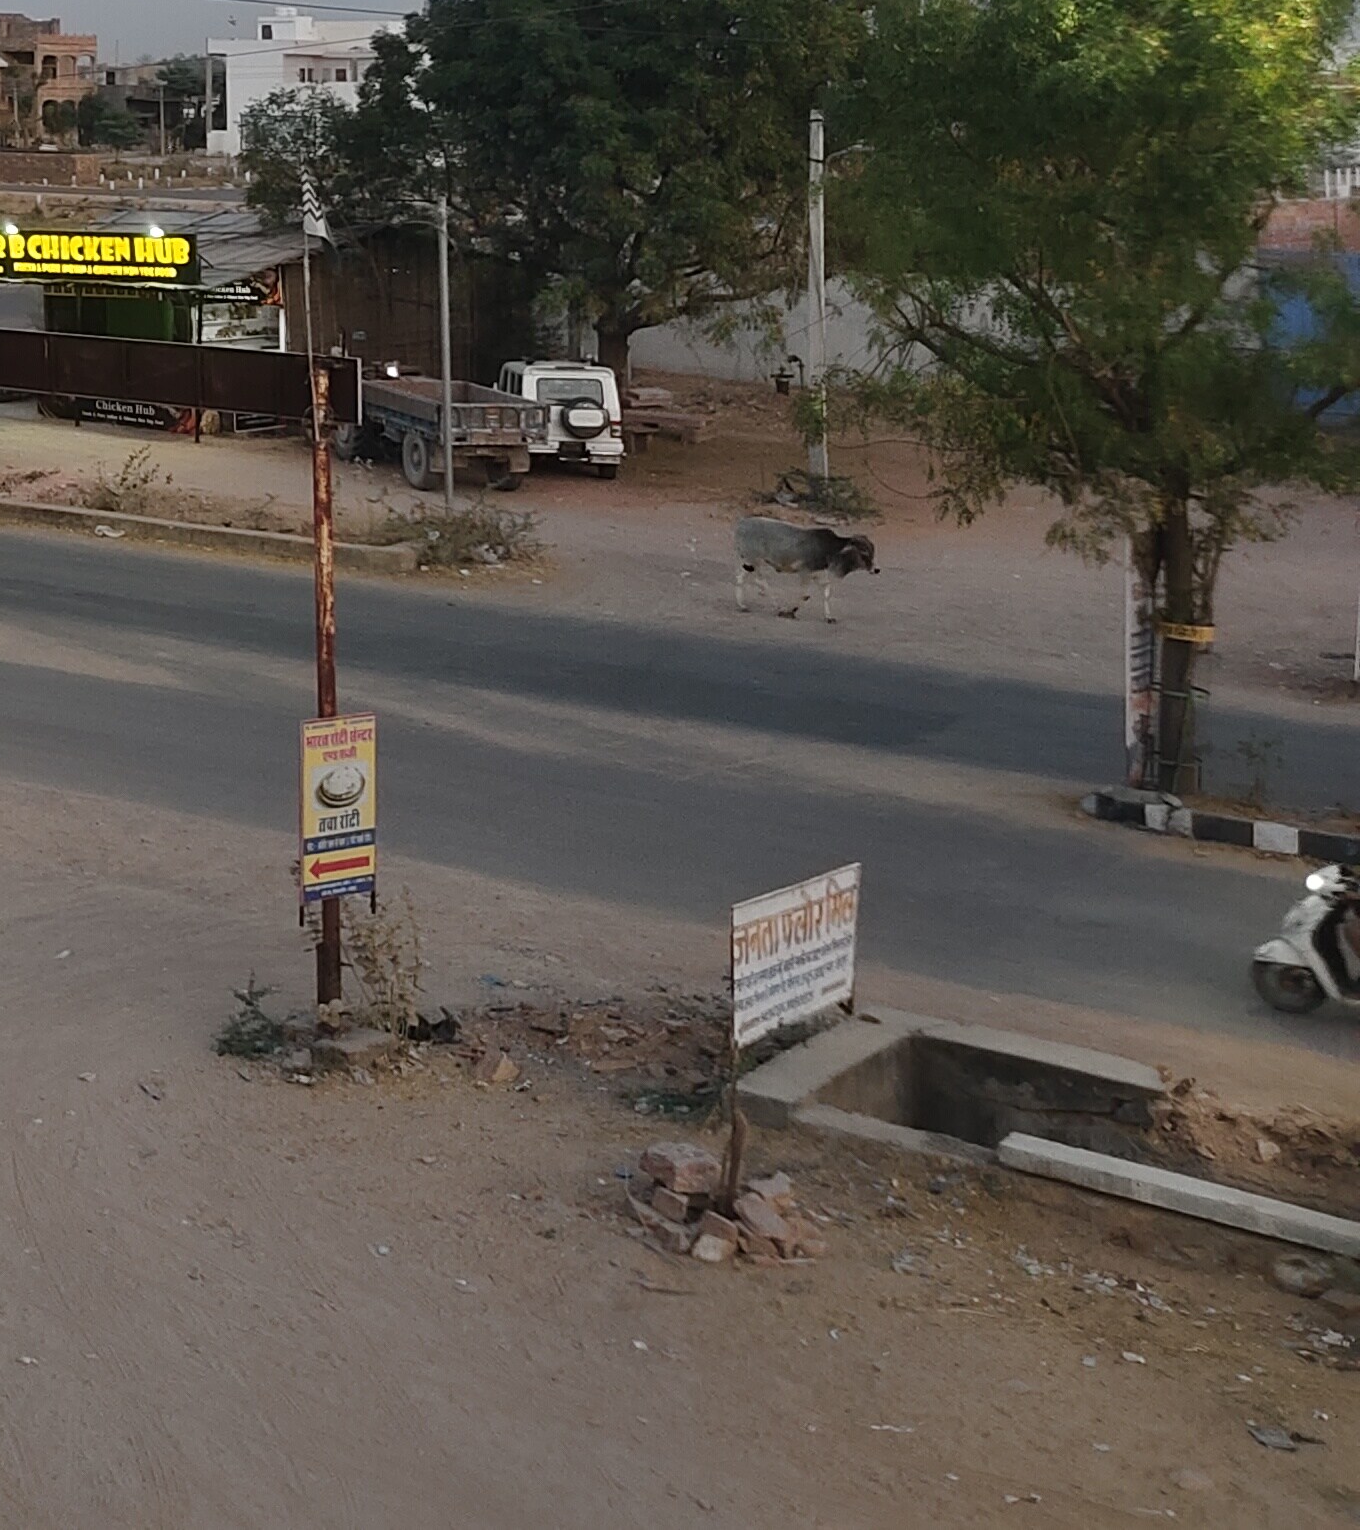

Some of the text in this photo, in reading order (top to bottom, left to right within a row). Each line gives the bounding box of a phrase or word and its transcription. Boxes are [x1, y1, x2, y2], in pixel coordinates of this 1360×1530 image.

[27, 234, 131, 261] CHICKEN
[133, 237, 190, 264] HUB
[95, 399, 155, 416] Chicken Hub
[319, 815, 337, 832] तवा
